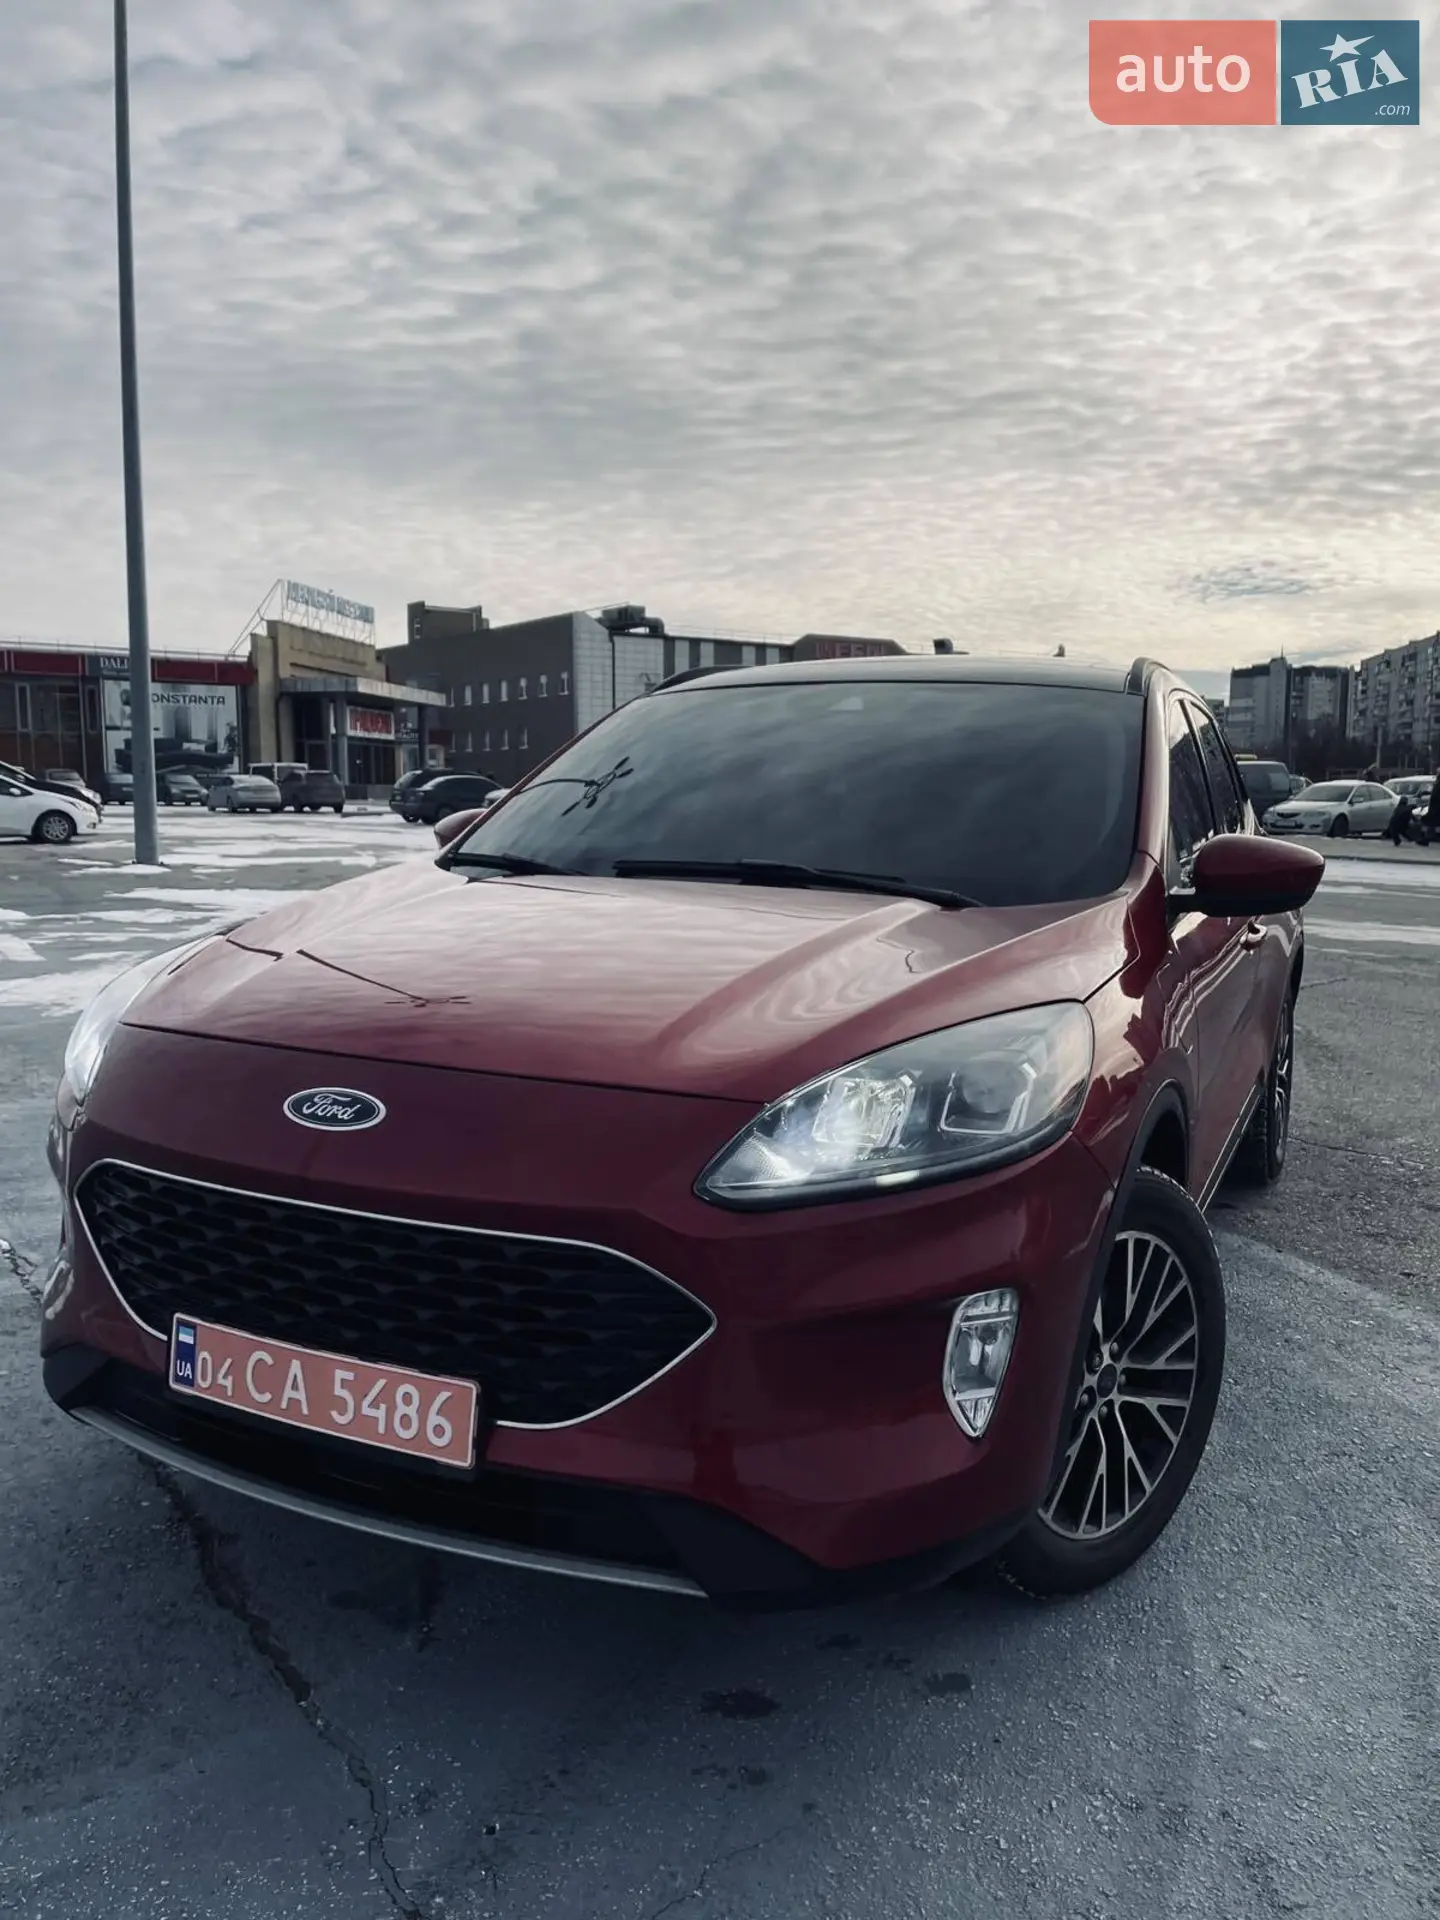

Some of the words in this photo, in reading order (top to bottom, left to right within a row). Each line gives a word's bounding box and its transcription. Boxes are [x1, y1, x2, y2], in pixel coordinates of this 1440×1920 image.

[151, 692, 226, 706] ONSTANTA
[302, 1093, 361, 1120] Ford
[176, 1359, 193, 1379] UA
[197, 1351, 233, 1397] 04
[245, 1350, 309, 1415] CA
[330, 1368, 453, 1447] 5486
